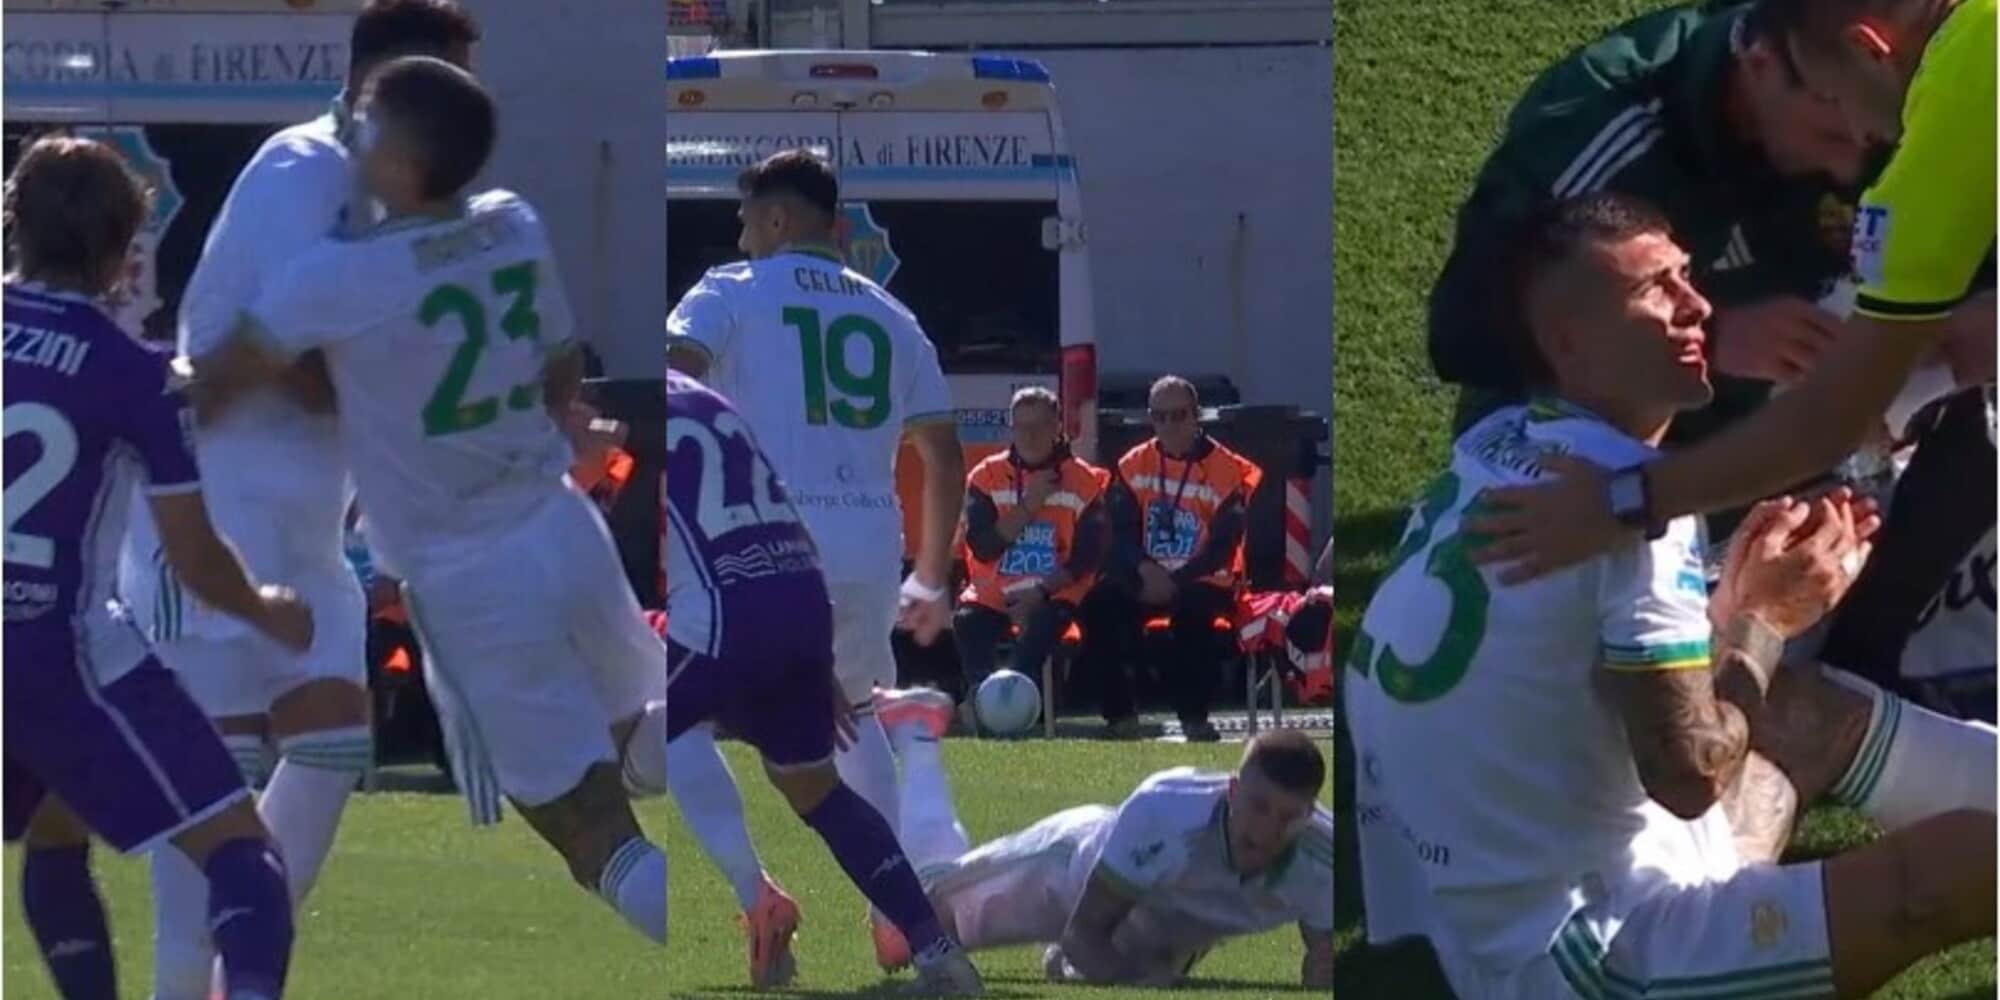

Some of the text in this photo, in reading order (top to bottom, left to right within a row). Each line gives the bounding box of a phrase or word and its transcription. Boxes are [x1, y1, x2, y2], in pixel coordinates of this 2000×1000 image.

[189, 42, 343, 82] FIRENZE
[876, 143, 893, 166] di
[906, 135, 1028, 167] FIRENZE
[419, 261, 540, 436] 23
[782, 306, 892, 430] 19
